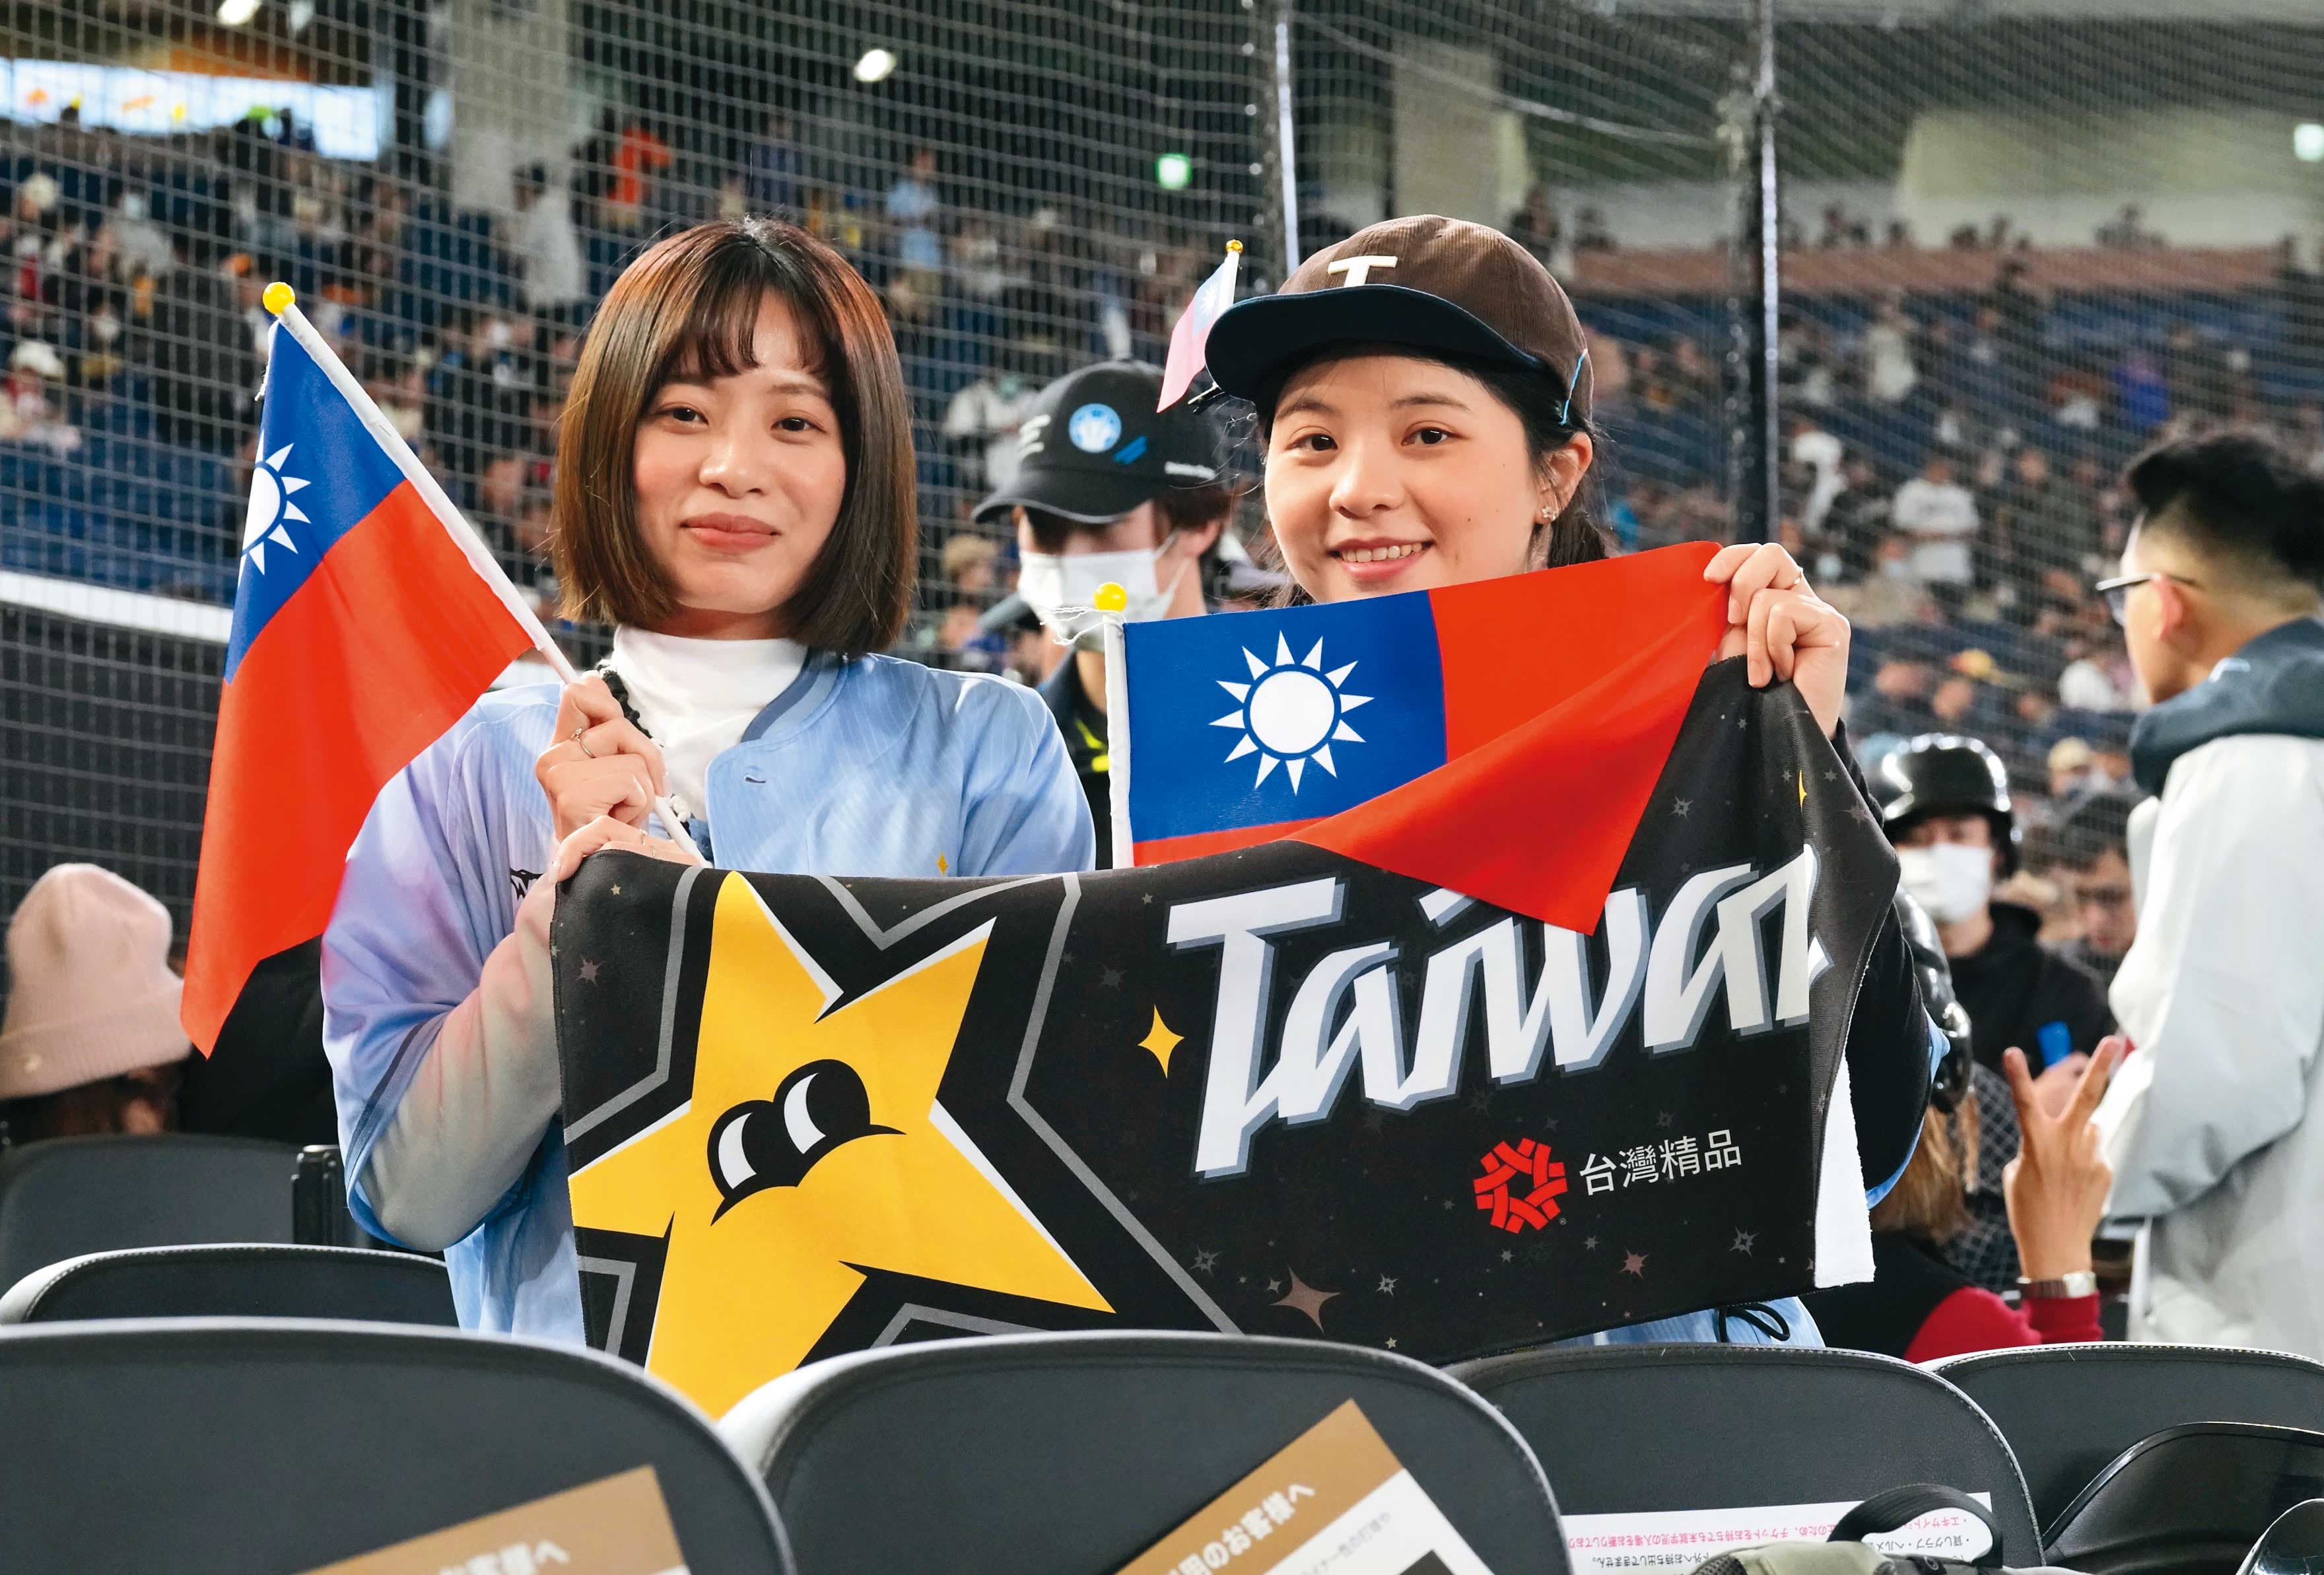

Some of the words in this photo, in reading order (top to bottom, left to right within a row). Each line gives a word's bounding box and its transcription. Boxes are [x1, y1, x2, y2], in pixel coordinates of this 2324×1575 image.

[1327, 254, 1398, 289] T
[1579, 1129, 1742, 1196] 台灣精品
[1163, 1483, 1316, 1575] 用のお客様へ
